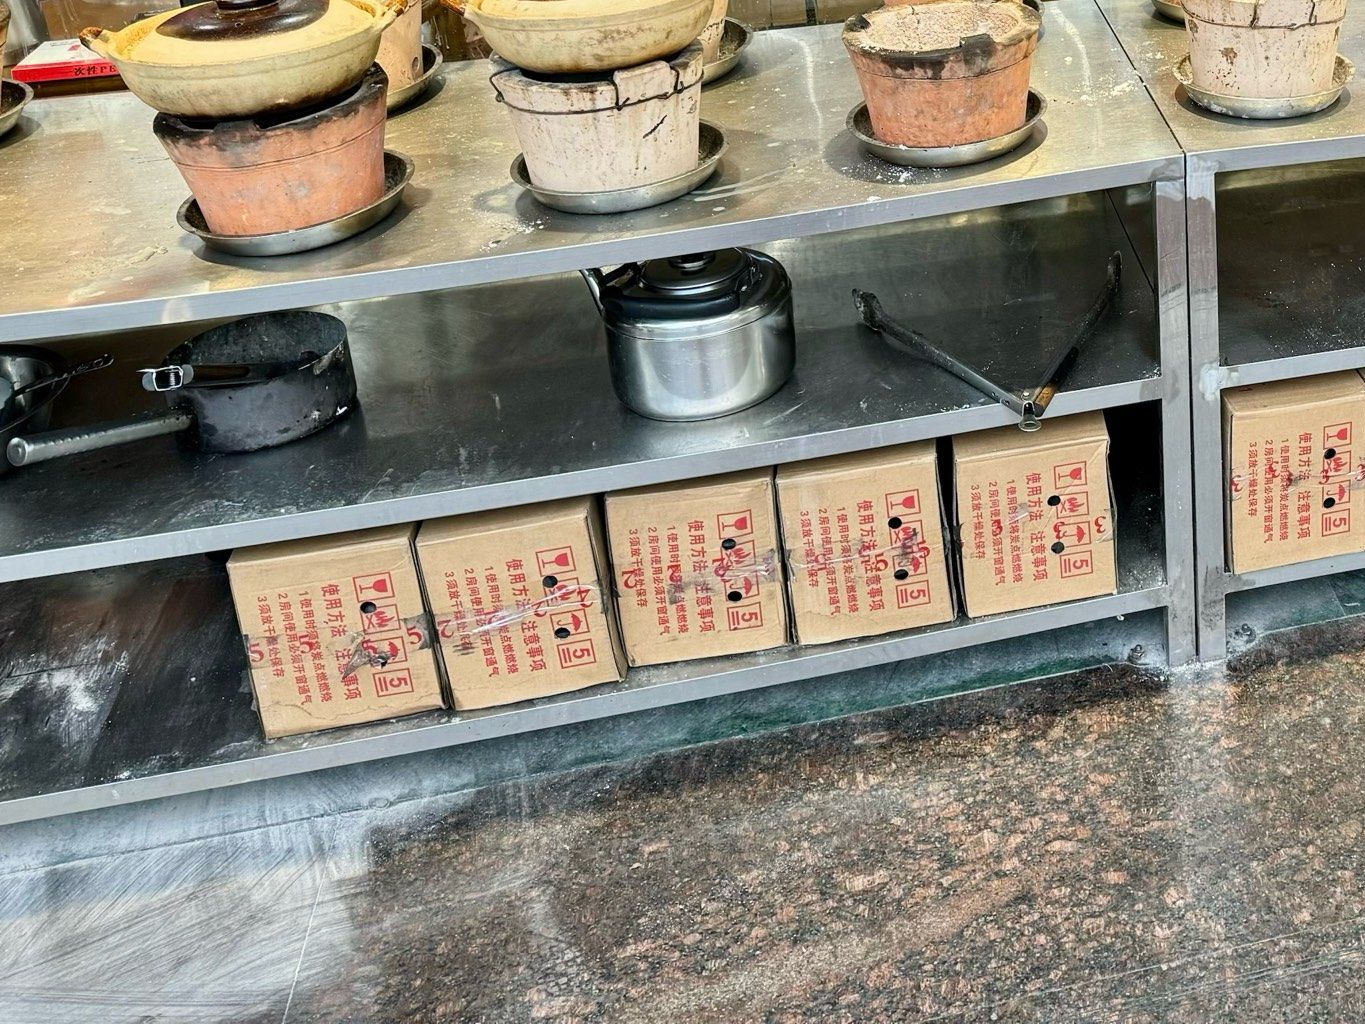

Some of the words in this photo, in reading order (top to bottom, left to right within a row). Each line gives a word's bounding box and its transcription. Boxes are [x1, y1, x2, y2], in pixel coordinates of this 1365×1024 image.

[1026, 473, 1043, 522] 使用方法
[1297, 491, 1311, 539] 注意事项
[1332, 517, 1346, 527] 5
[688, 520, 711, 572] 使用方法
[1030, 531, 1047, 581] 注意事项
[1072, 559, 1089, 570] 5
[910, 589, 926, 599] 5
[322, 584, 346, 638] 使用方法
[741, 612, 758, 622] 5
[521, 621, 546, 672] 注意事项
[573, 648, 591, 658] 5
[390, 677, 407, 688] 5
